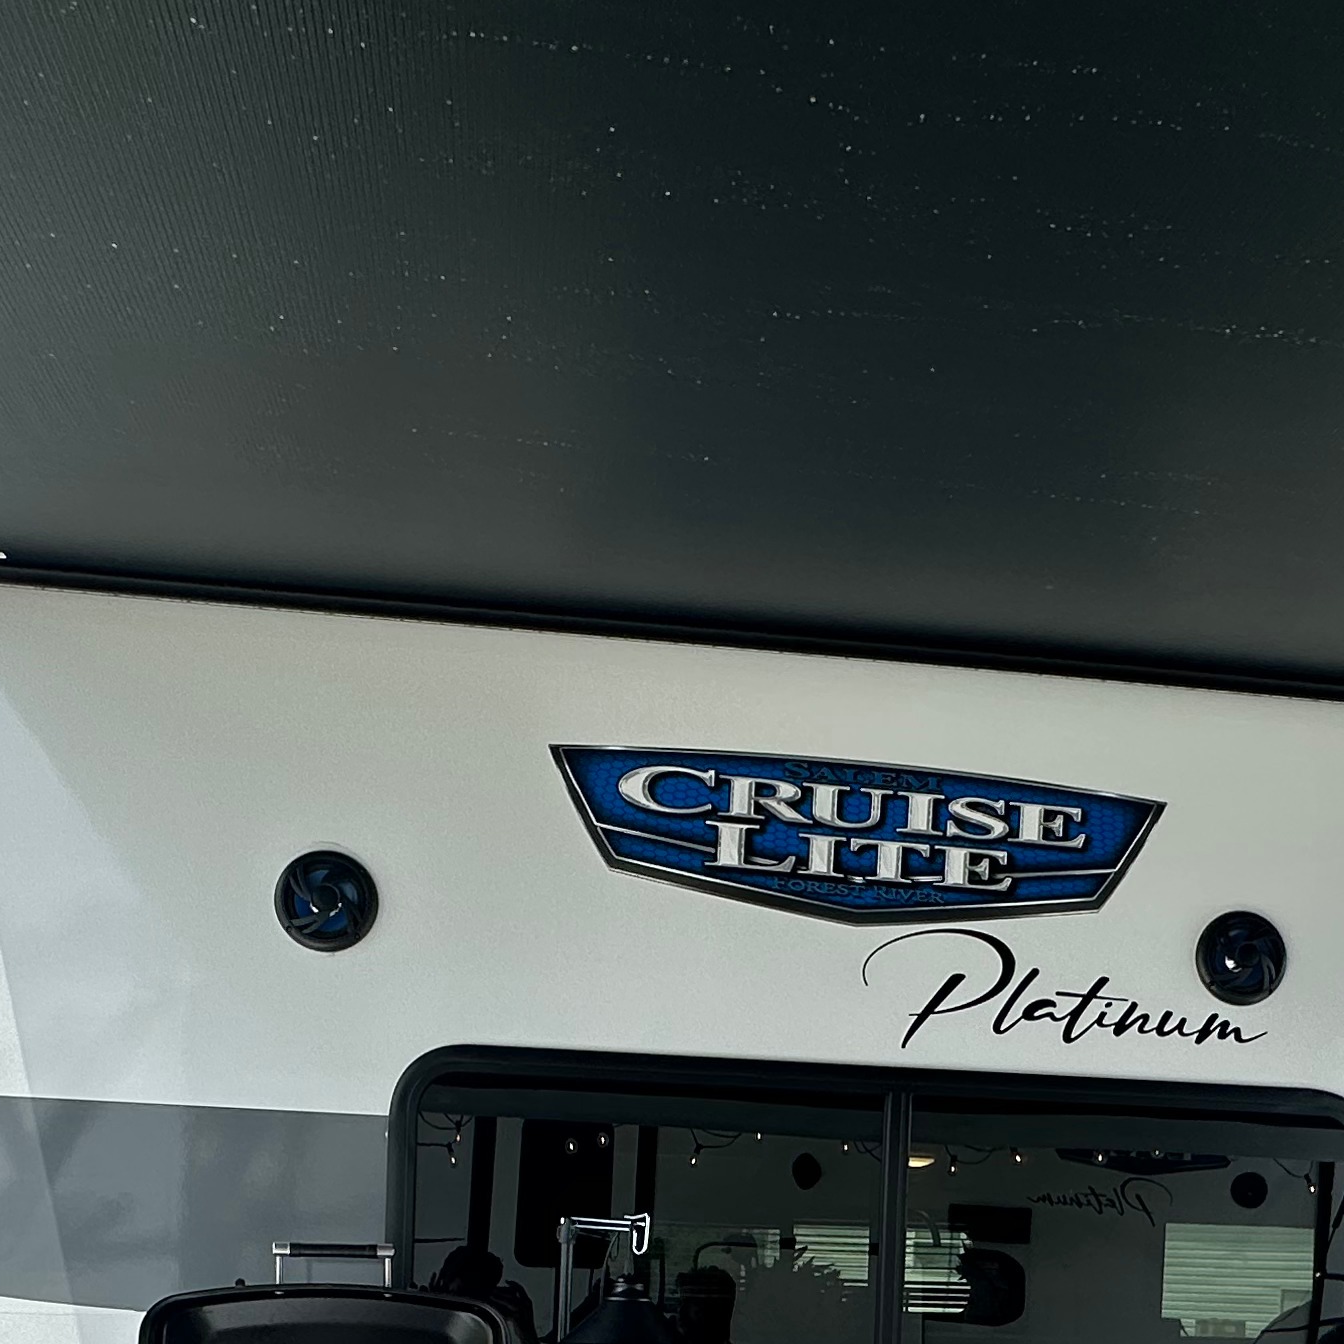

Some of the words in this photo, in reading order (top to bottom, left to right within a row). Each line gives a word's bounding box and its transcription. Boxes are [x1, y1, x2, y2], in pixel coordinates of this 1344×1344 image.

[619, 765, 1087, 850] CRUISE
[784, 762, 943, 791] SALEM
[704, 820, 1013, 892] LITE
[772, 876, 864, 898] FOREST
[875, 886, 945, 904] RIVER
[862, 929, 1267, 1049] Platinum
